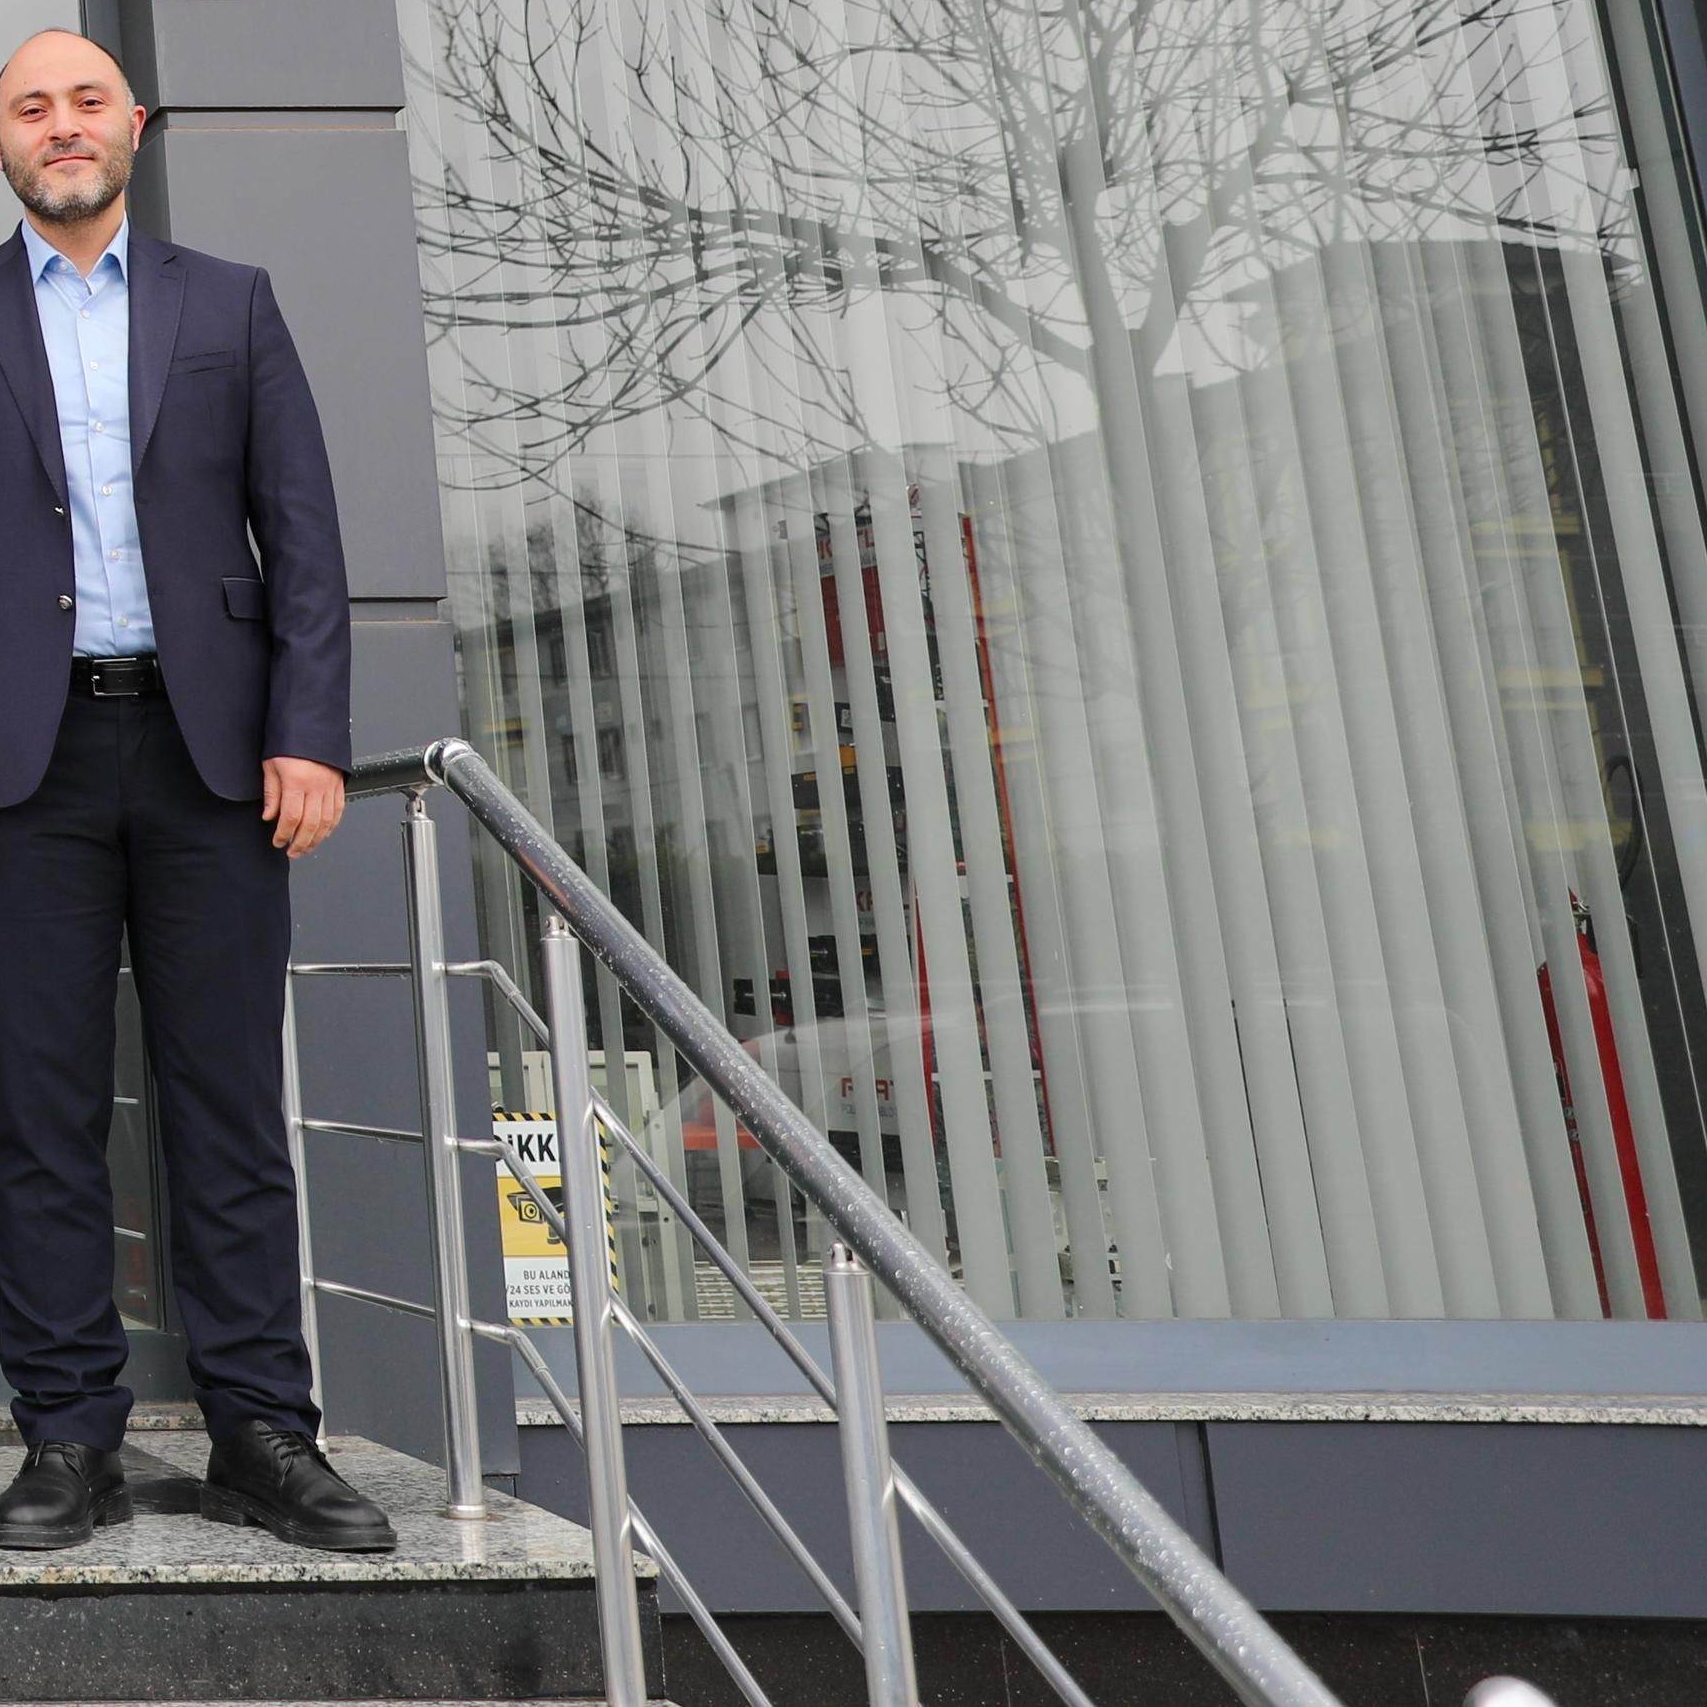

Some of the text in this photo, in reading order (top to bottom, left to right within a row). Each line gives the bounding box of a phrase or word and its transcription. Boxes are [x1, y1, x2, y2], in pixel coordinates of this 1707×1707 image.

[523, 1270, 571, 1280] BU ALAND
[505, 1283, 572, 1294] /24 SES VE GÖ
[509, 1300, 532, 1308] KAYDI
